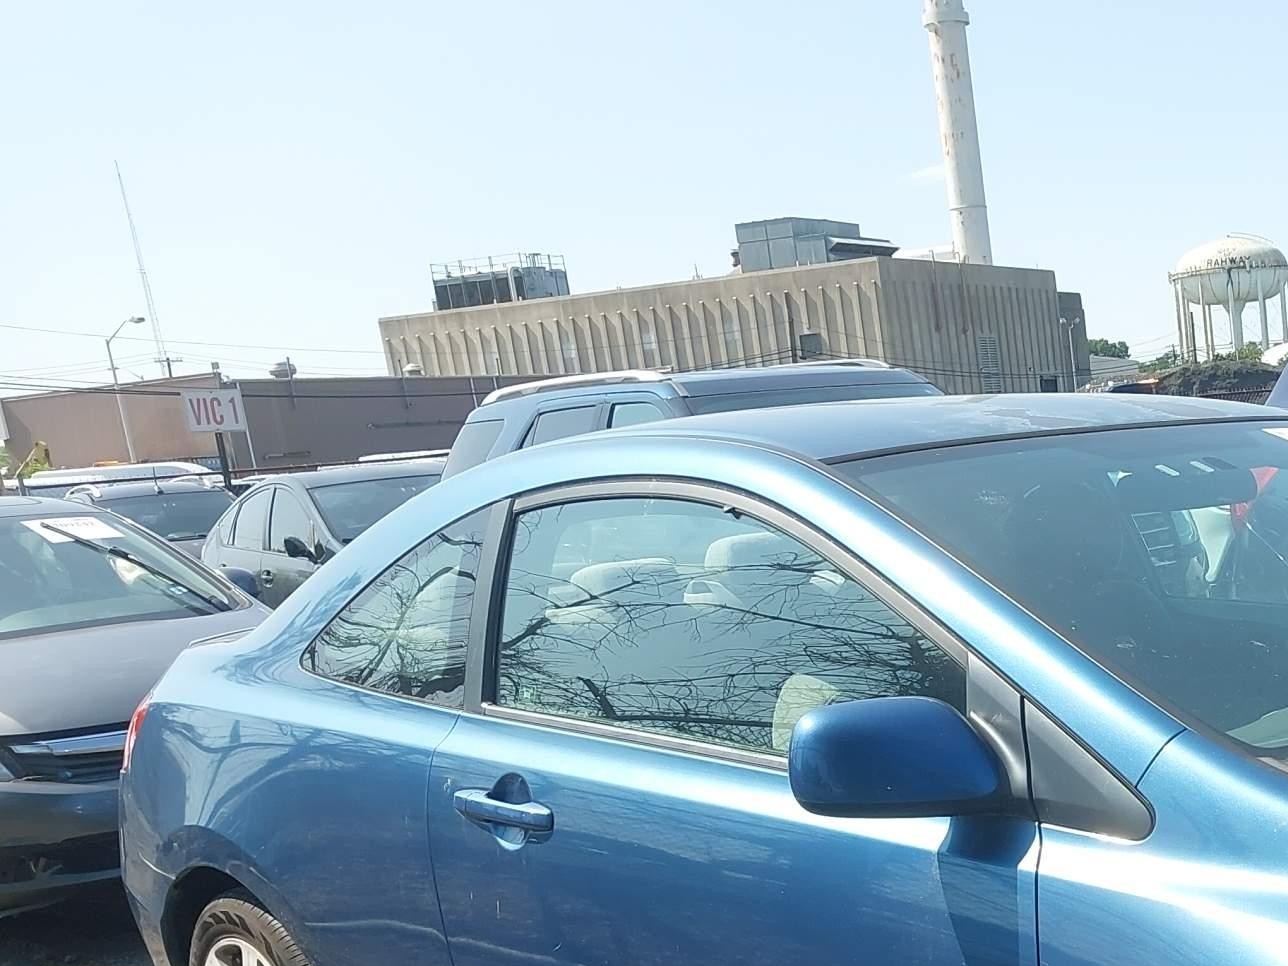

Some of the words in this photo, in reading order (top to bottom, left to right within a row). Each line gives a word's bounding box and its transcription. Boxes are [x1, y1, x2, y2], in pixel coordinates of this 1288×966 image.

[1206, 255, 1251, 268] RAHWAY
[188, 397, 225, 426] VIC
[228, 396, 240, 425] 1
